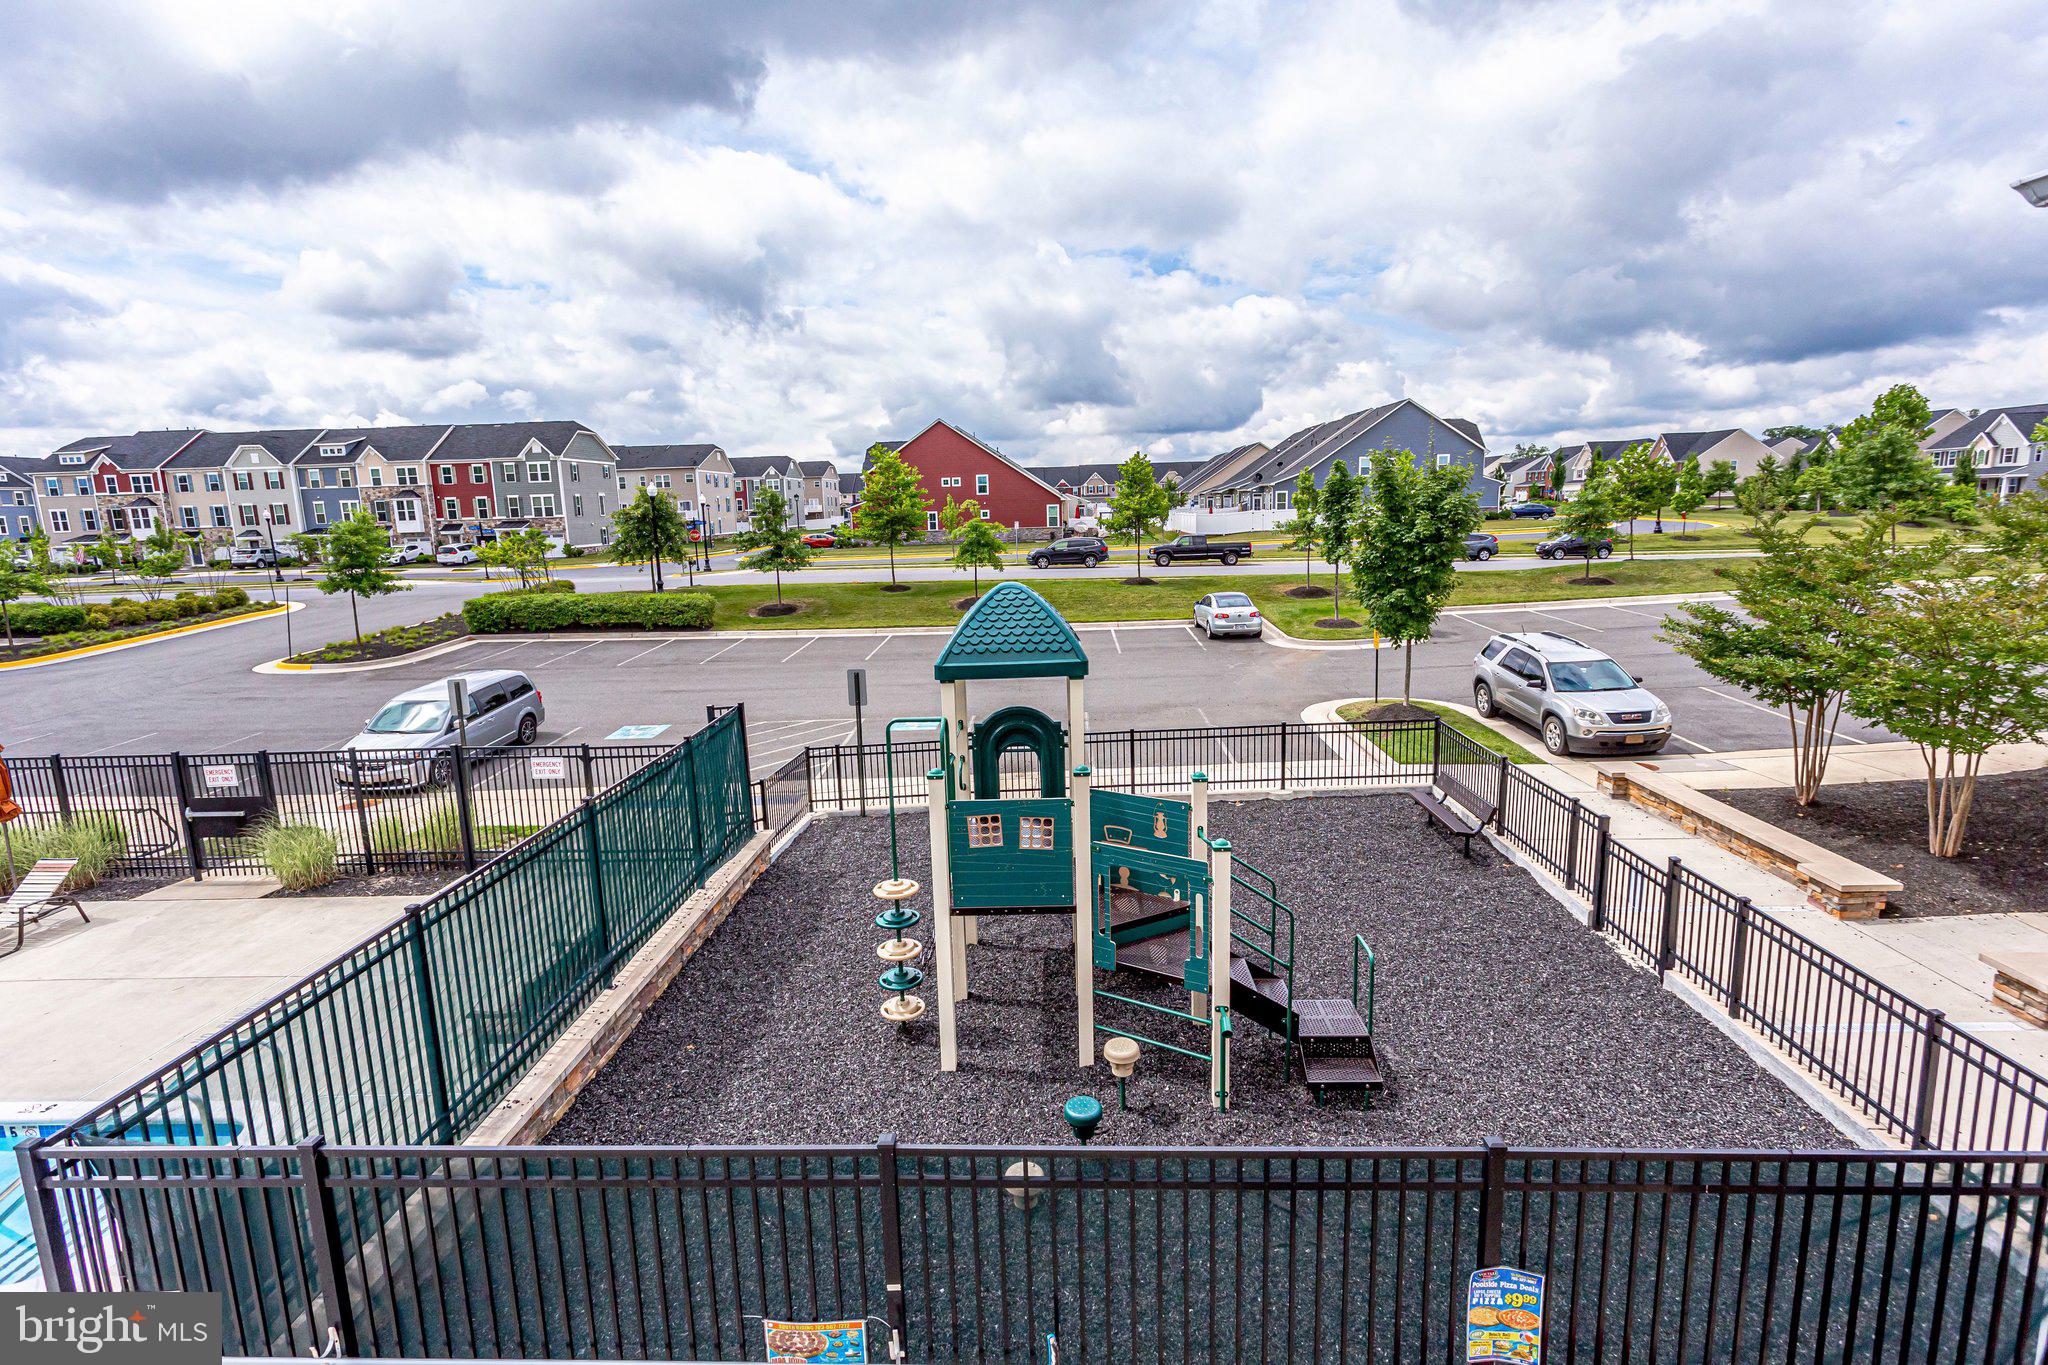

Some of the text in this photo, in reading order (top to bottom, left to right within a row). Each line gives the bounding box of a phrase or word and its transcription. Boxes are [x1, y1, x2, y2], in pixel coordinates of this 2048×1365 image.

[9, 1126, 18, 1138] 5
[1500, 1281, 1517, 1289] Pizza
[1519, 1284, 1539, 1293] Deals
